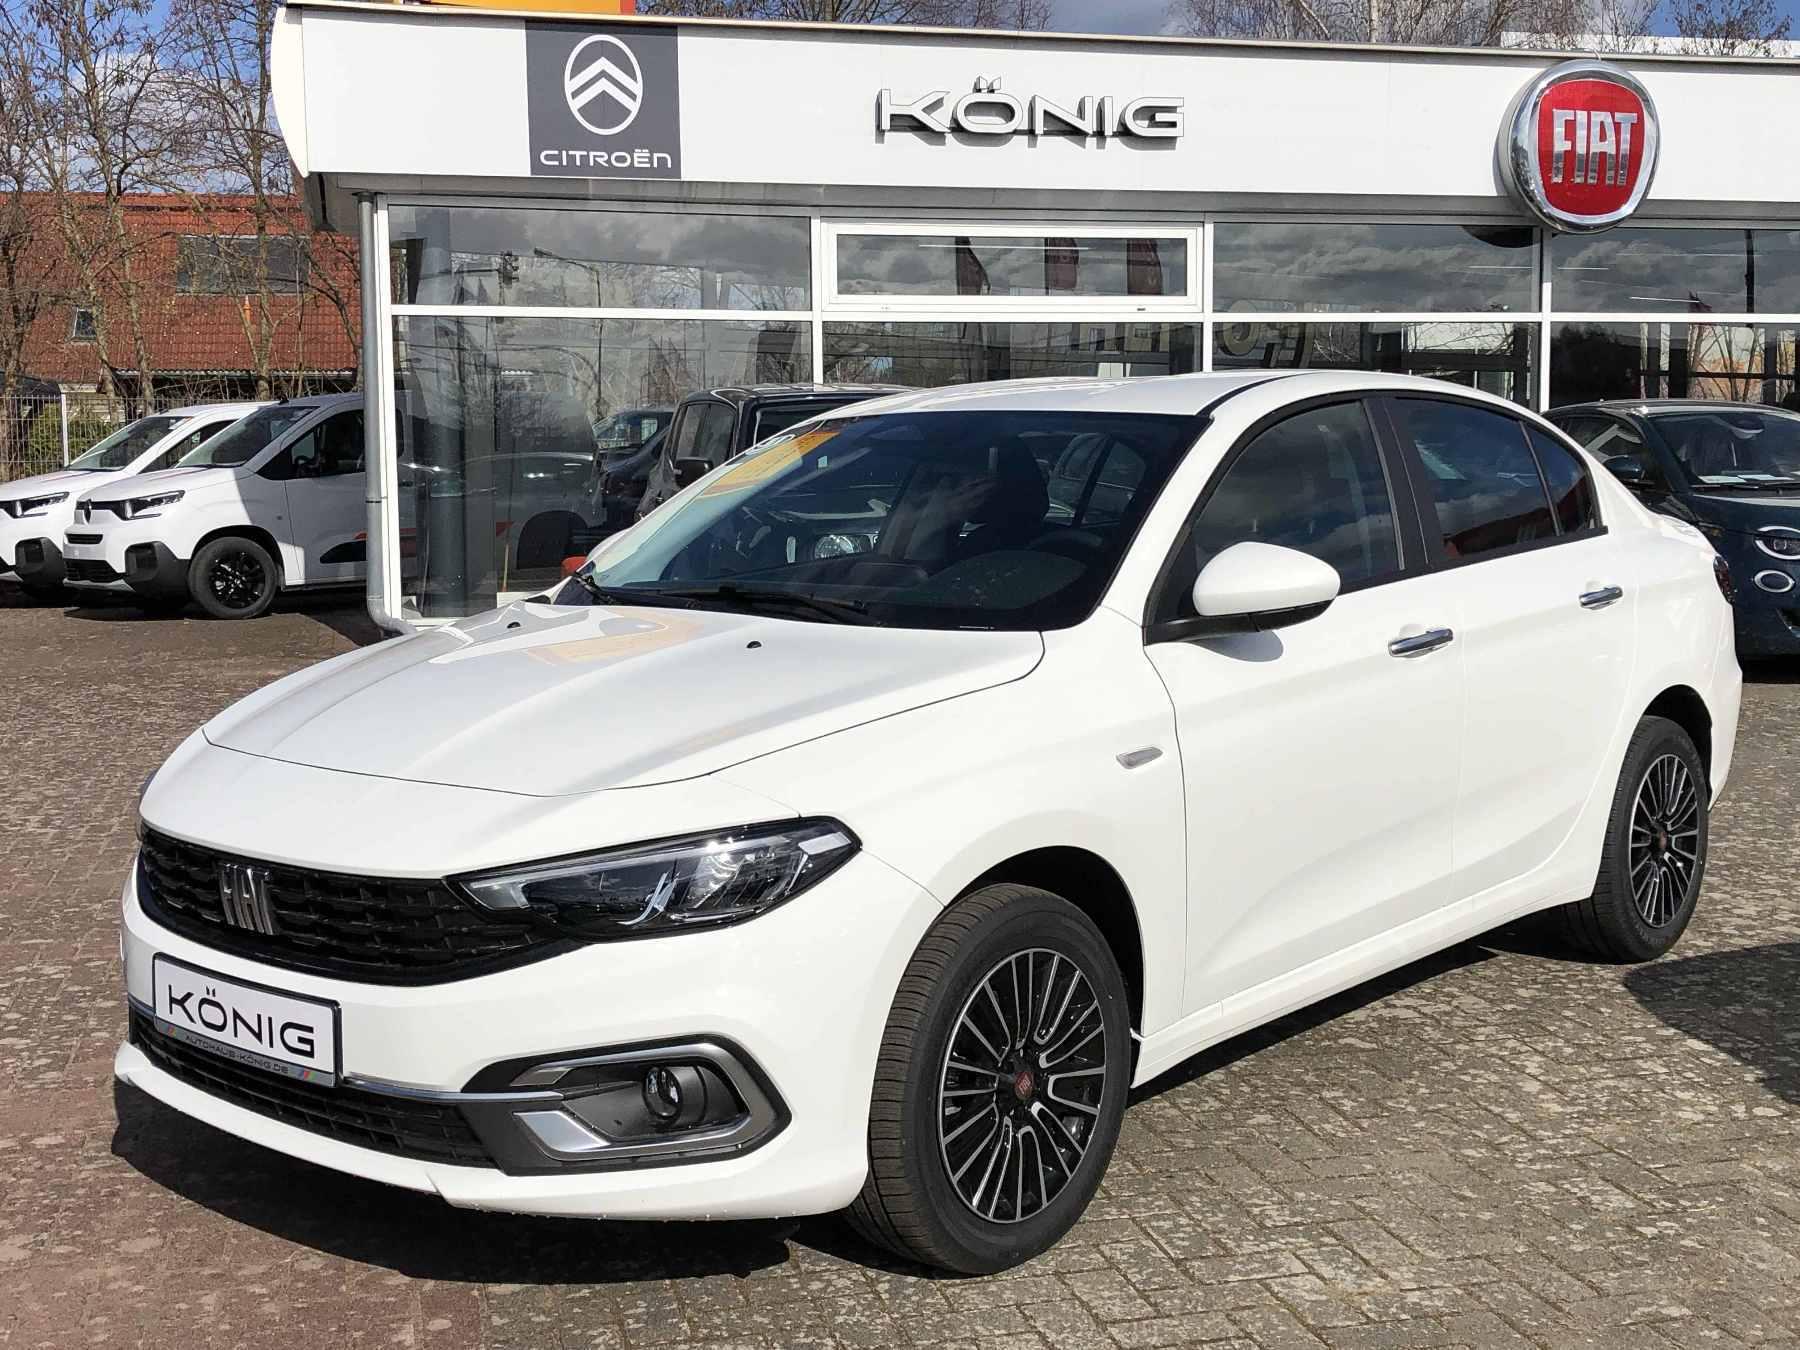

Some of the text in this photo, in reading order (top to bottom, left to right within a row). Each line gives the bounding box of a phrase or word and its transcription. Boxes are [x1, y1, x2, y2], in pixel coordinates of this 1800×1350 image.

[878, 76, 1185, 139] KÖNIG
[1552, 108, 1638, 186] FIAT
[168, 984, 316, 1060] KÖNIG
